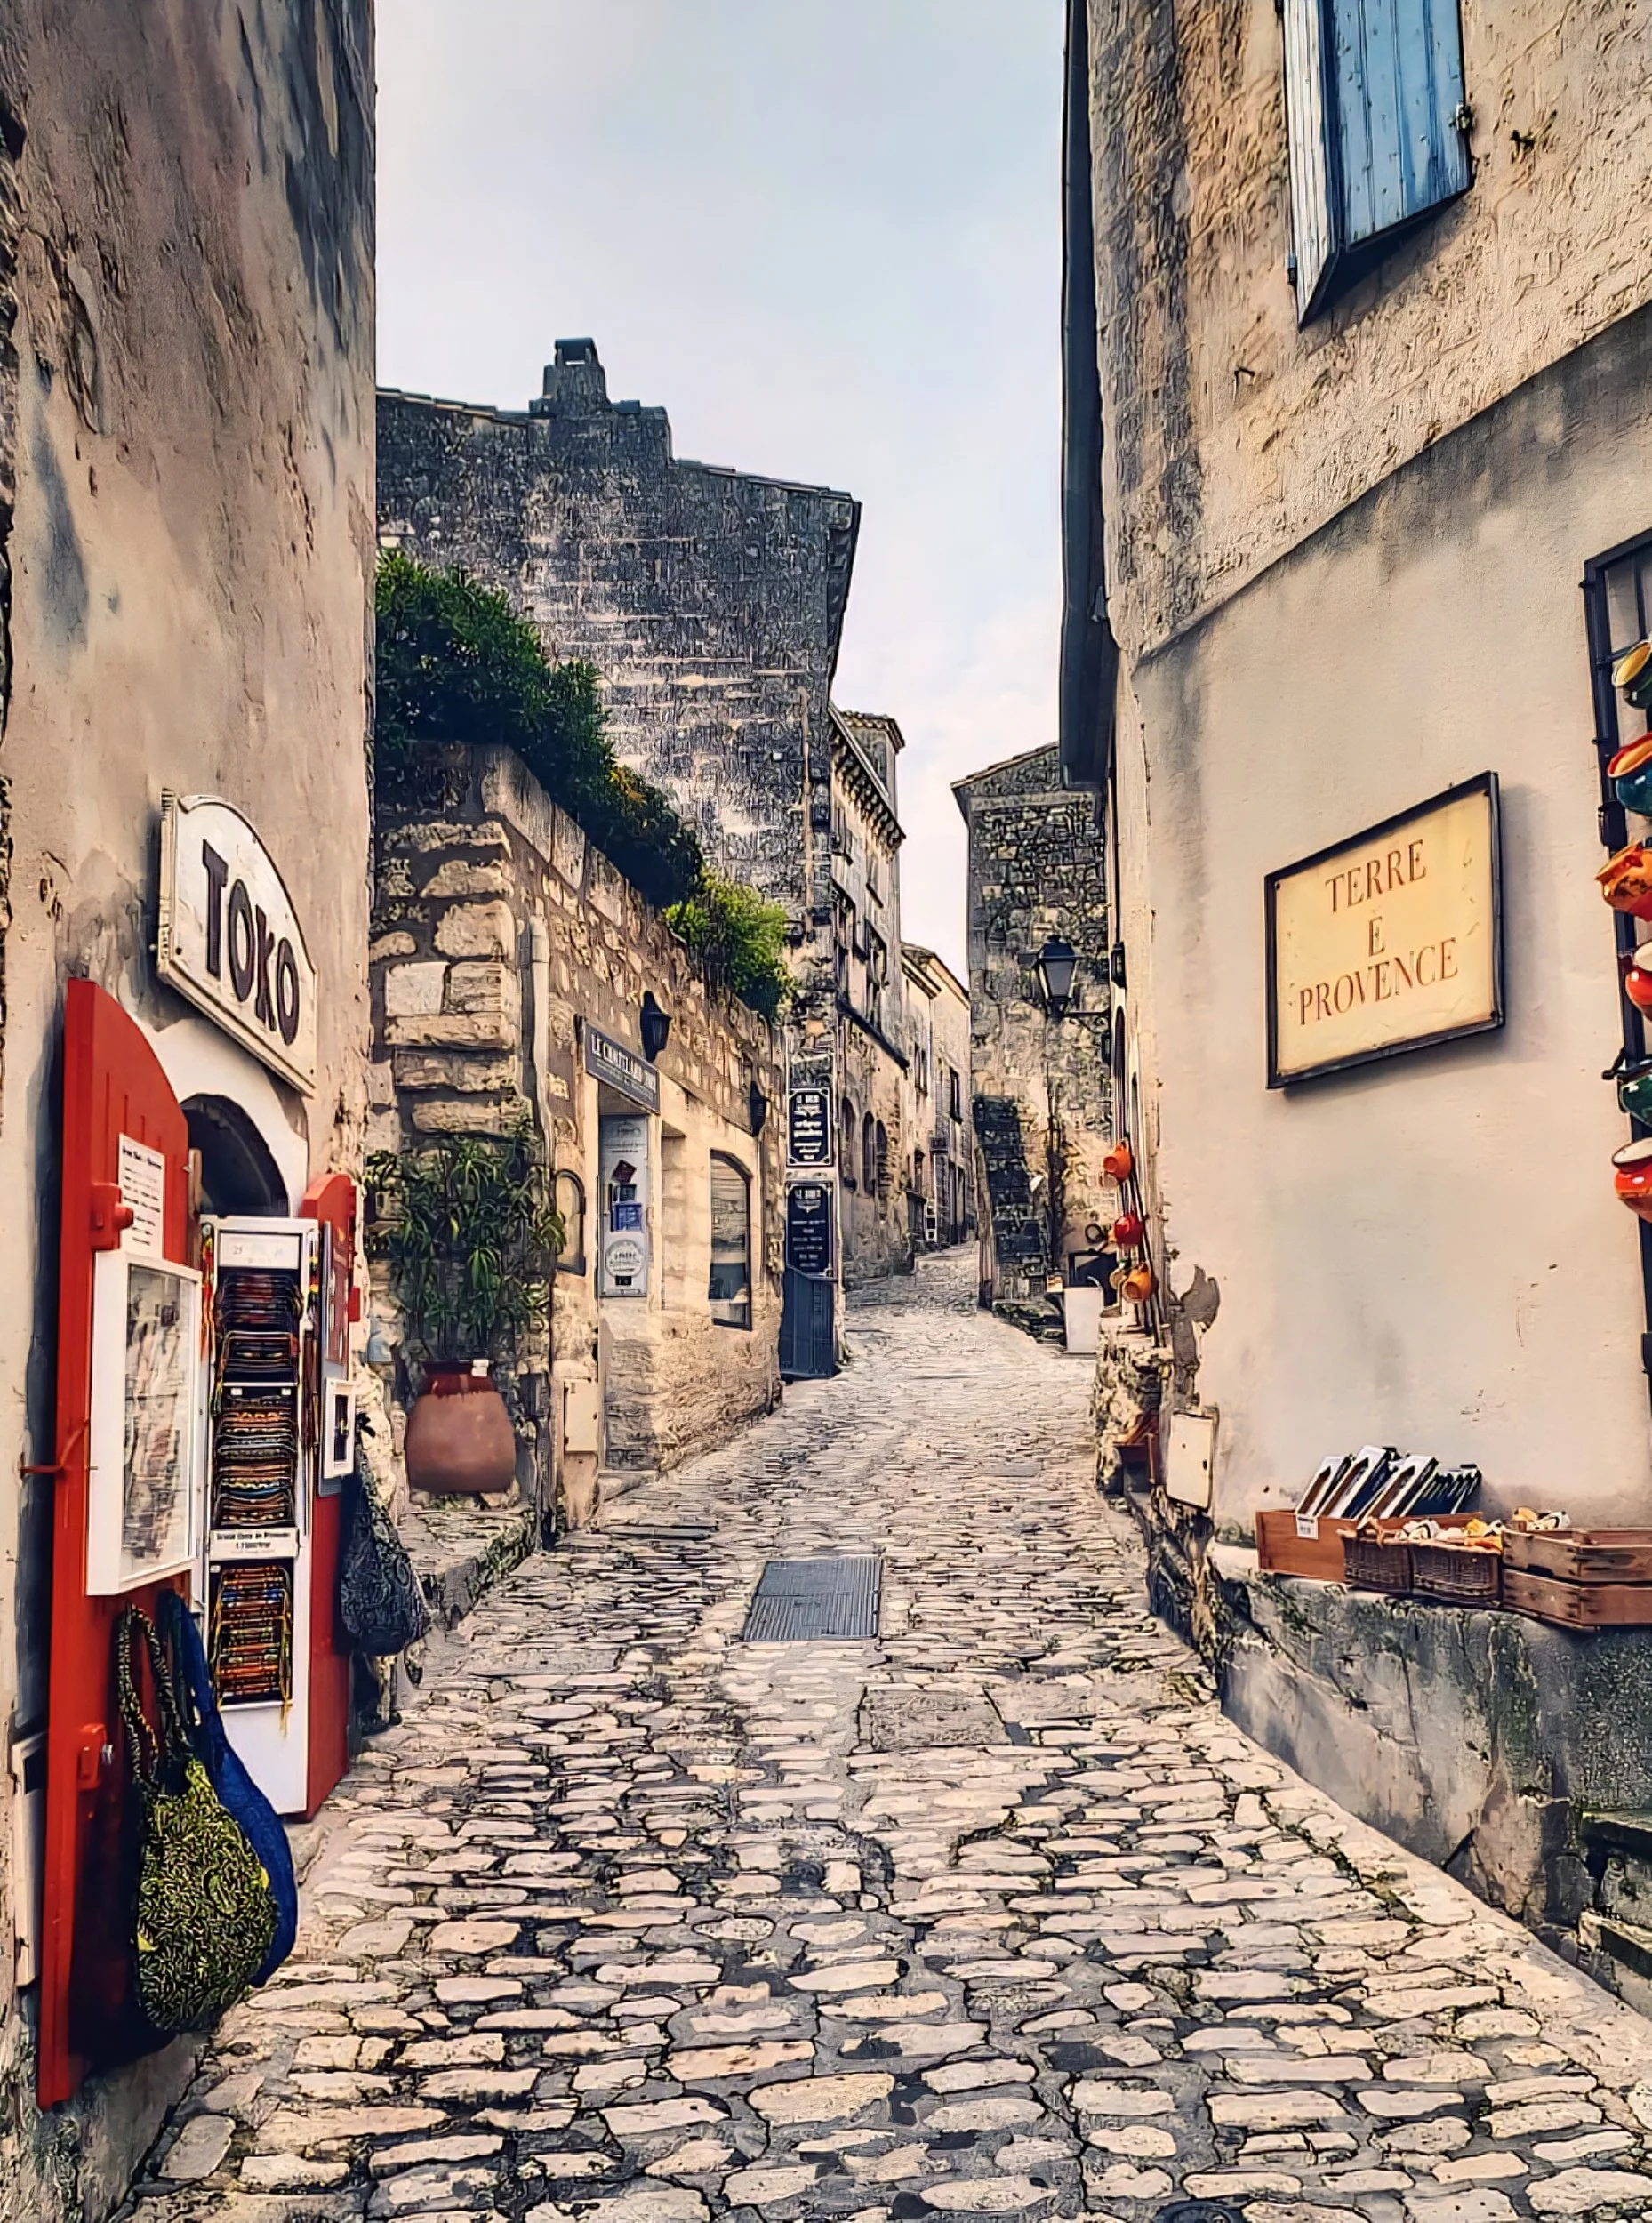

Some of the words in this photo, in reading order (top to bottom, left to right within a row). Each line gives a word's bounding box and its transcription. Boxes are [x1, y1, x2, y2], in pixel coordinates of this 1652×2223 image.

[1324, 839, 1428, 913] TERRE
[202, 838, 300, 1047] TOKO
[1367, 915, 1386, 958] E
[1299, 936, 1459, 1026] PROVENCE
